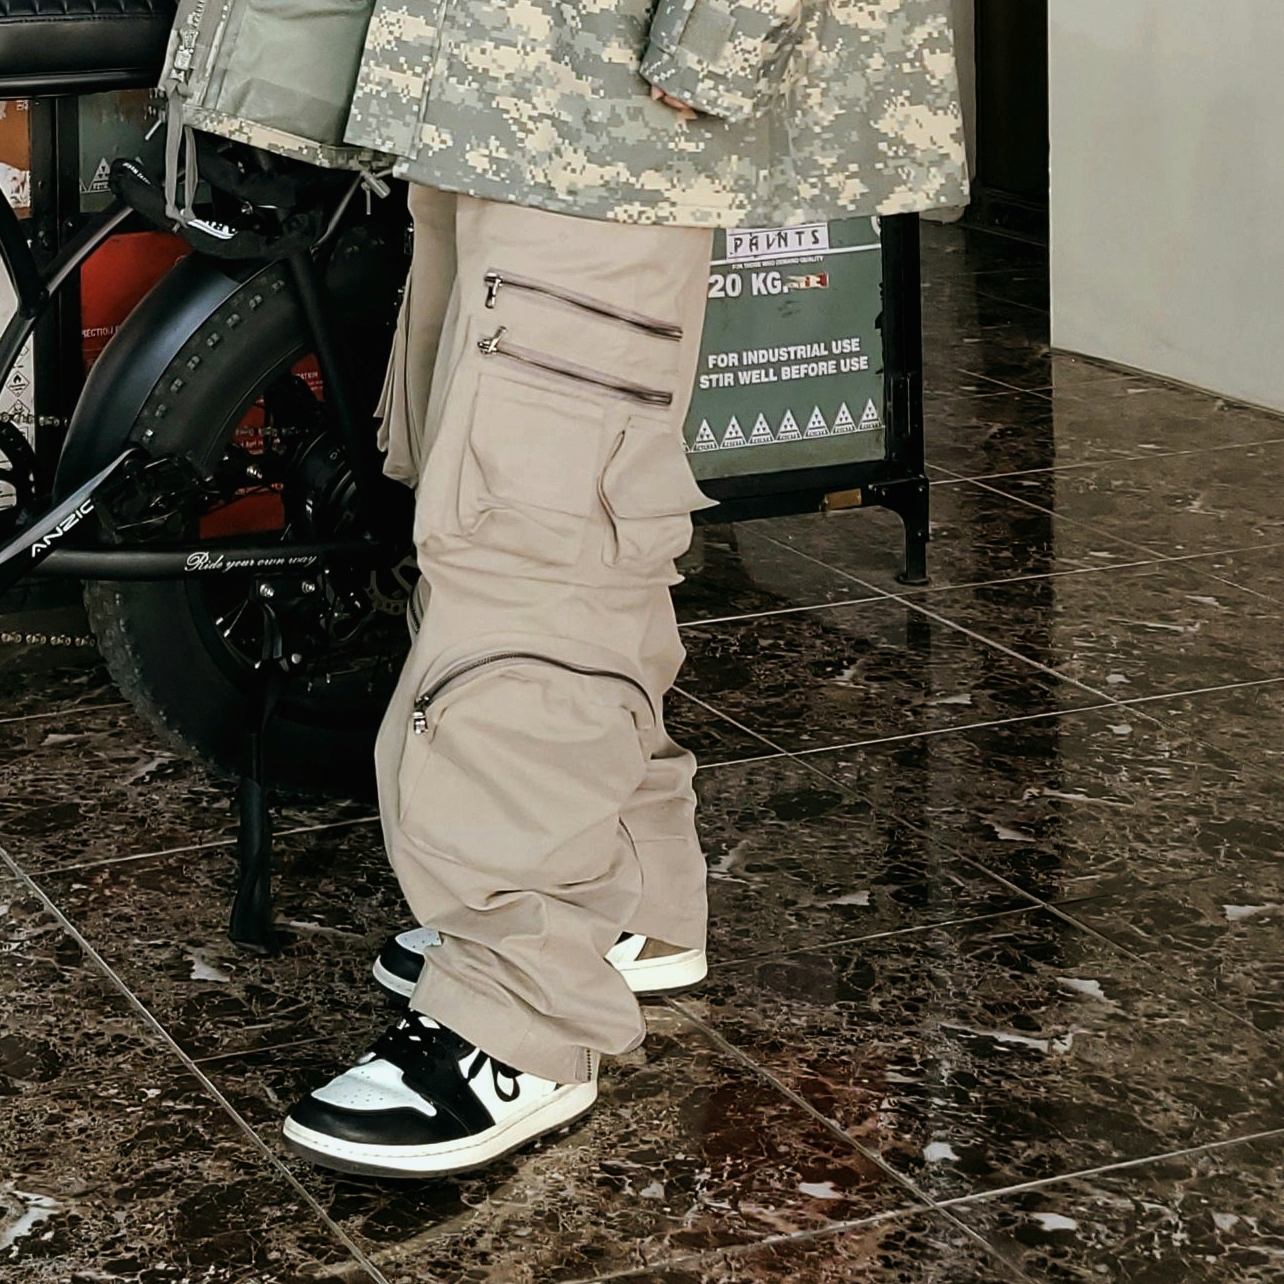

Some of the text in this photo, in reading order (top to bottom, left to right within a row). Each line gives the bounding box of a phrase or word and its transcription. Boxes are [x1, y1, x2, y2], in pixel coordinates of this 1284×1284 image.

[708, 271, 789, 298] 20 KG.
[708, 337, 861, 369] FOR INDUSTRIAL USE
[699, 356, 869, 389] STIR WELL BEFORE USE
[222, 559, 255, 573] your
[257, 557, 285, 566] own
